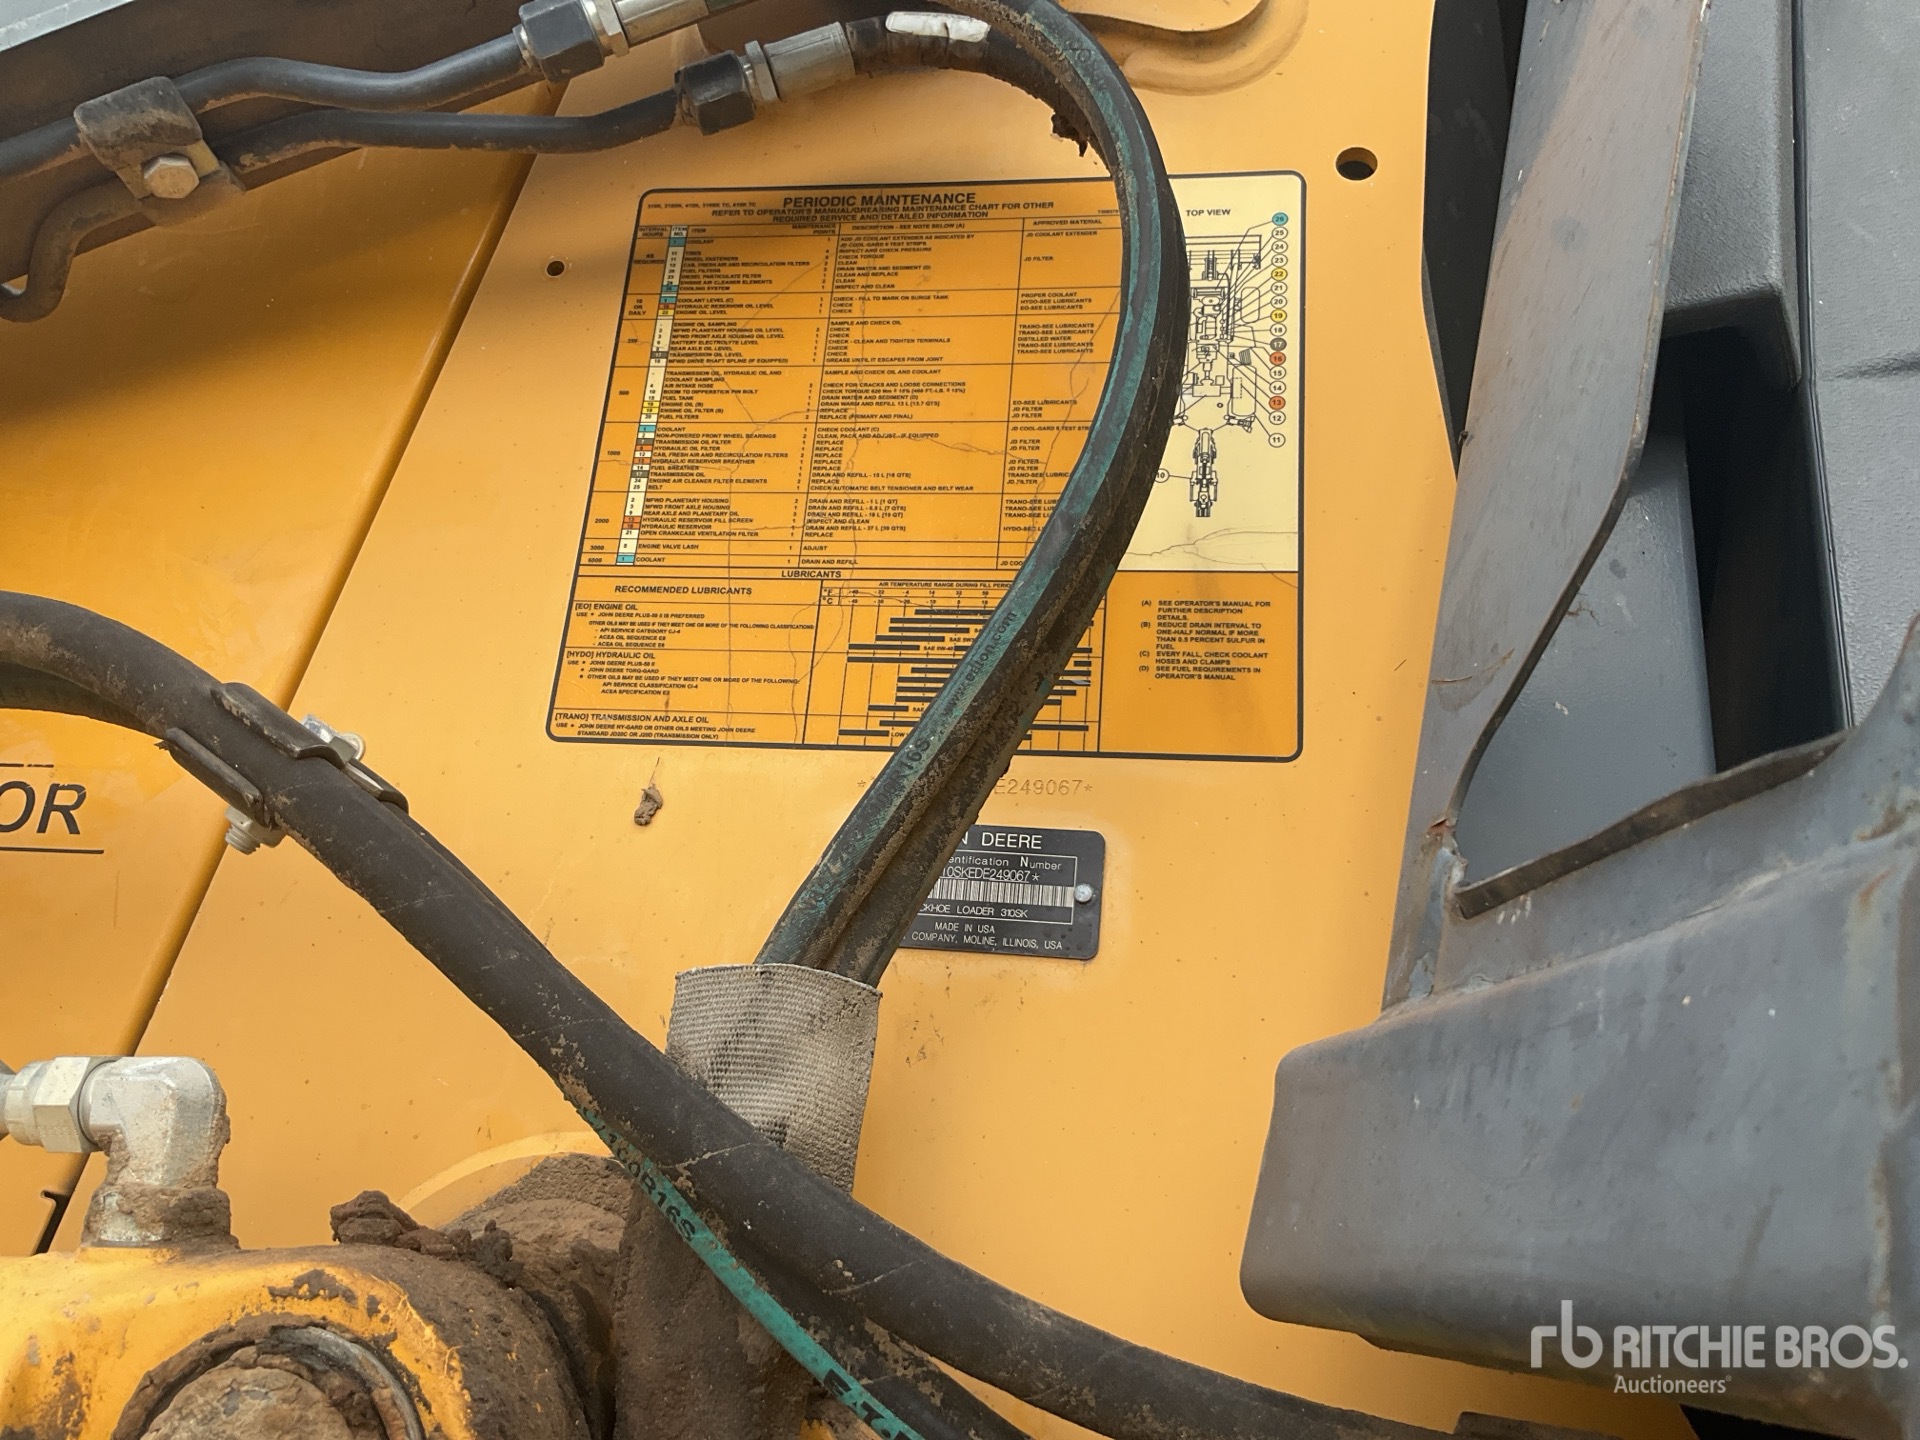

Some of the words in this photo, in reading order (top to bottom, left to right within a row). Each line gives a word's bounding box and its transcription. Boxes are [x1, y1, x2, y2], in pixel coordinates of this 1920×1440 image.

[783, 195, 856, 208] PERIODIC
[860, 193, 975, 206] MAINTENANCE
[711, 209, 740, 217] REFER
[756, 207, 812, 216] OPERATOR'S
[813, 205, 900, 214] MANUAL/GREASING
[901, 204, 966, 212] MAINTENANCE
[967, 203, 999, 211] CHART
[1001, 202, 1020, 210] FOR
[1022, 202, 1054, 210] OTHER
[1186, 209, 1204, 217] TOP
[1206, 208, 1230, 216] VIEW
[772, 215, 817, 223] REQUIRED
[819, 214, 857, 222] SERVICE
[859, 213, 879, 221] AND
[880, 212, 924, 220] DETAILED
[925, 211, 988, 219] INFORMATION
[781, 570, 841, 578] LUBRICANTS
[614, 585, 689, 595] RECOMMENDED
[690, 586, 752, 596] LUBRICANTS
[574, 603, 592, 611] [EO]
[593, 603, 623, 611] ENGINE
[624, 603, 637, 611] OIL
[566, 650, 594, 659] [HYDO]
[595, 651, 641, 659] HYDRAULIC
[642, 651, 655, 659] OIL
[554, 713, 589, 722] [TRANO]
[591, 714, 651, 723] TRANSMISSION
[652, 715, 670, 723] AND
[671, 715, 694, 724] AXLE
[695, 716, 708, 724] OIL
[981, 832, 1042, 849] DEERE
[948, 856, 1009, 866] entification
[1020, 857, 1061, 871] Number
[957, 906, 994, 915] LOADER
[1000, 909, 1028, 918] 310SK
[935, 922, 959, 931] MADE
[965, 924, 972, 932] IN
[977, 924, 995, 934] USA
[912, 931, 957, 943] COMPANY,
[963, 936, 997, 946] MOLINE,
[1002, 939, 1038, 949] ILLINOIS,
[1044, 940, 1062, 950] USA
